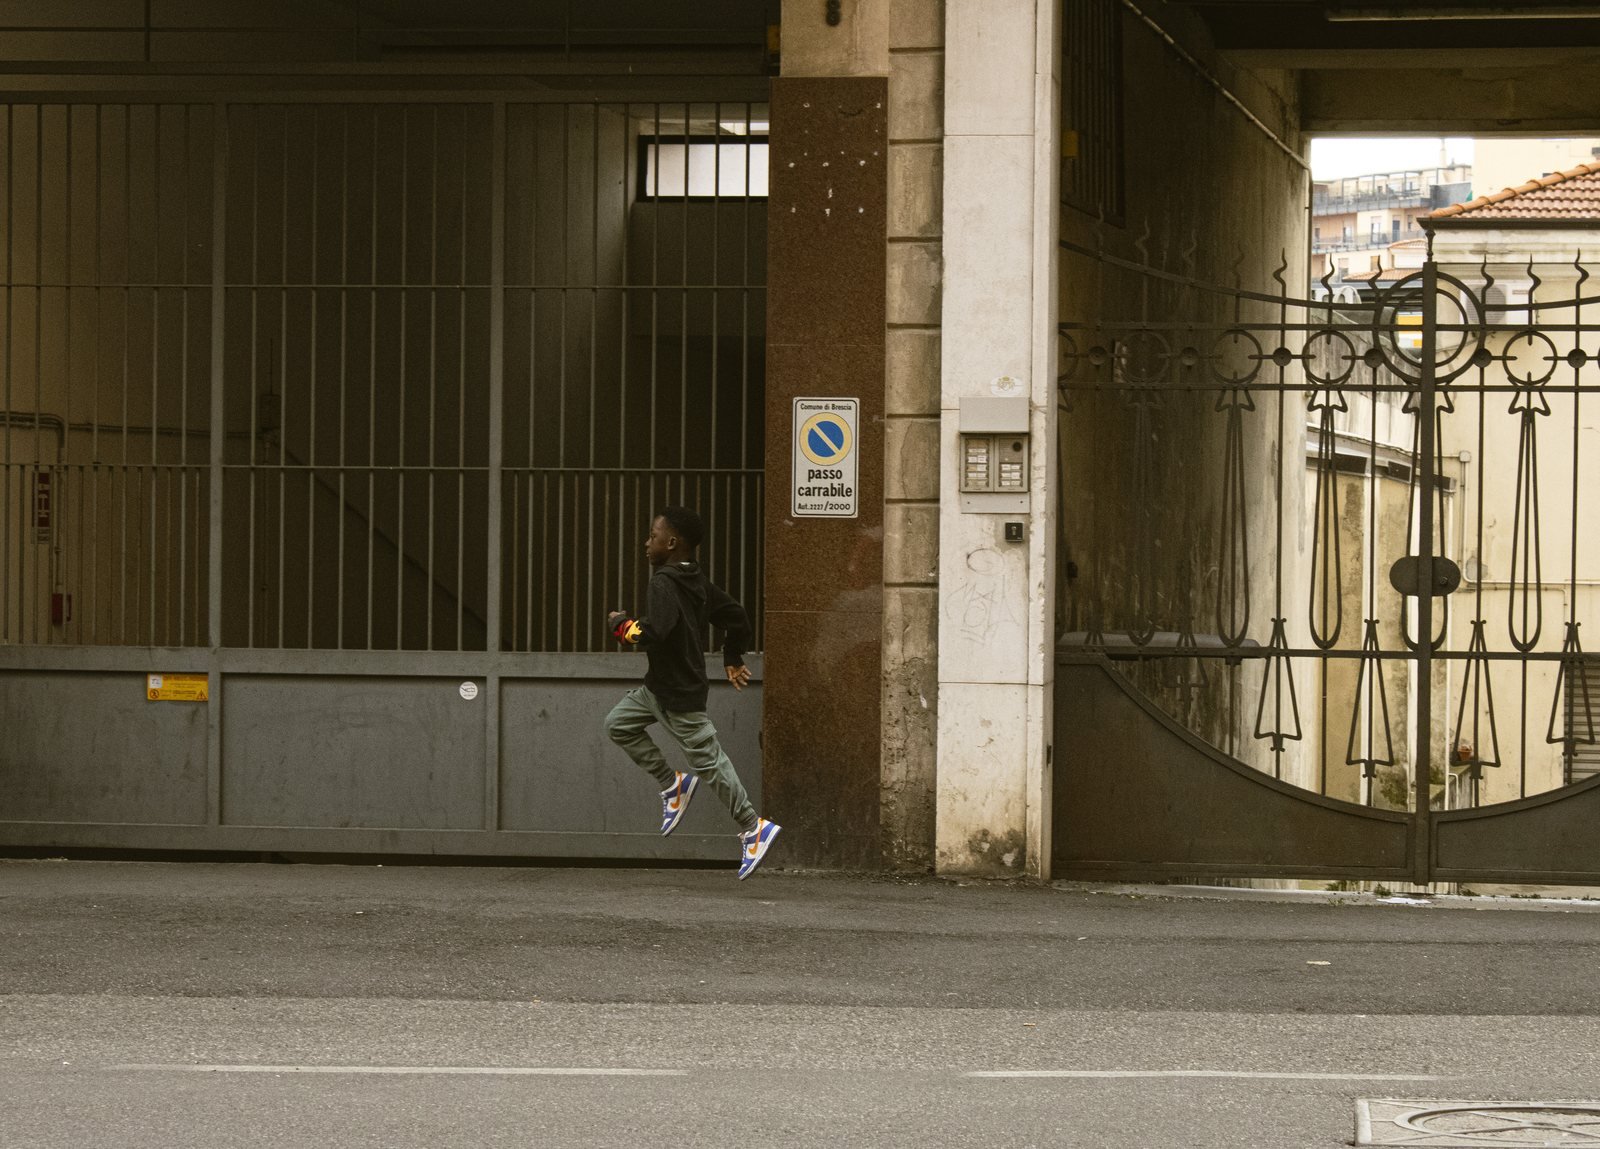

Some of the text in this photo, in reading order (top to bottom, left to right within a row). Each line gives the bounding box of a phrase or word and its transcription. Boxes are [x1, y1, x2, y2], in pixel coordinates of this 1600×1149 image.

[800, 403, 852, 411] Comune di Brescia
[807, 469, 843, 482] passo
[797, 483, 853, 497] carrabile
